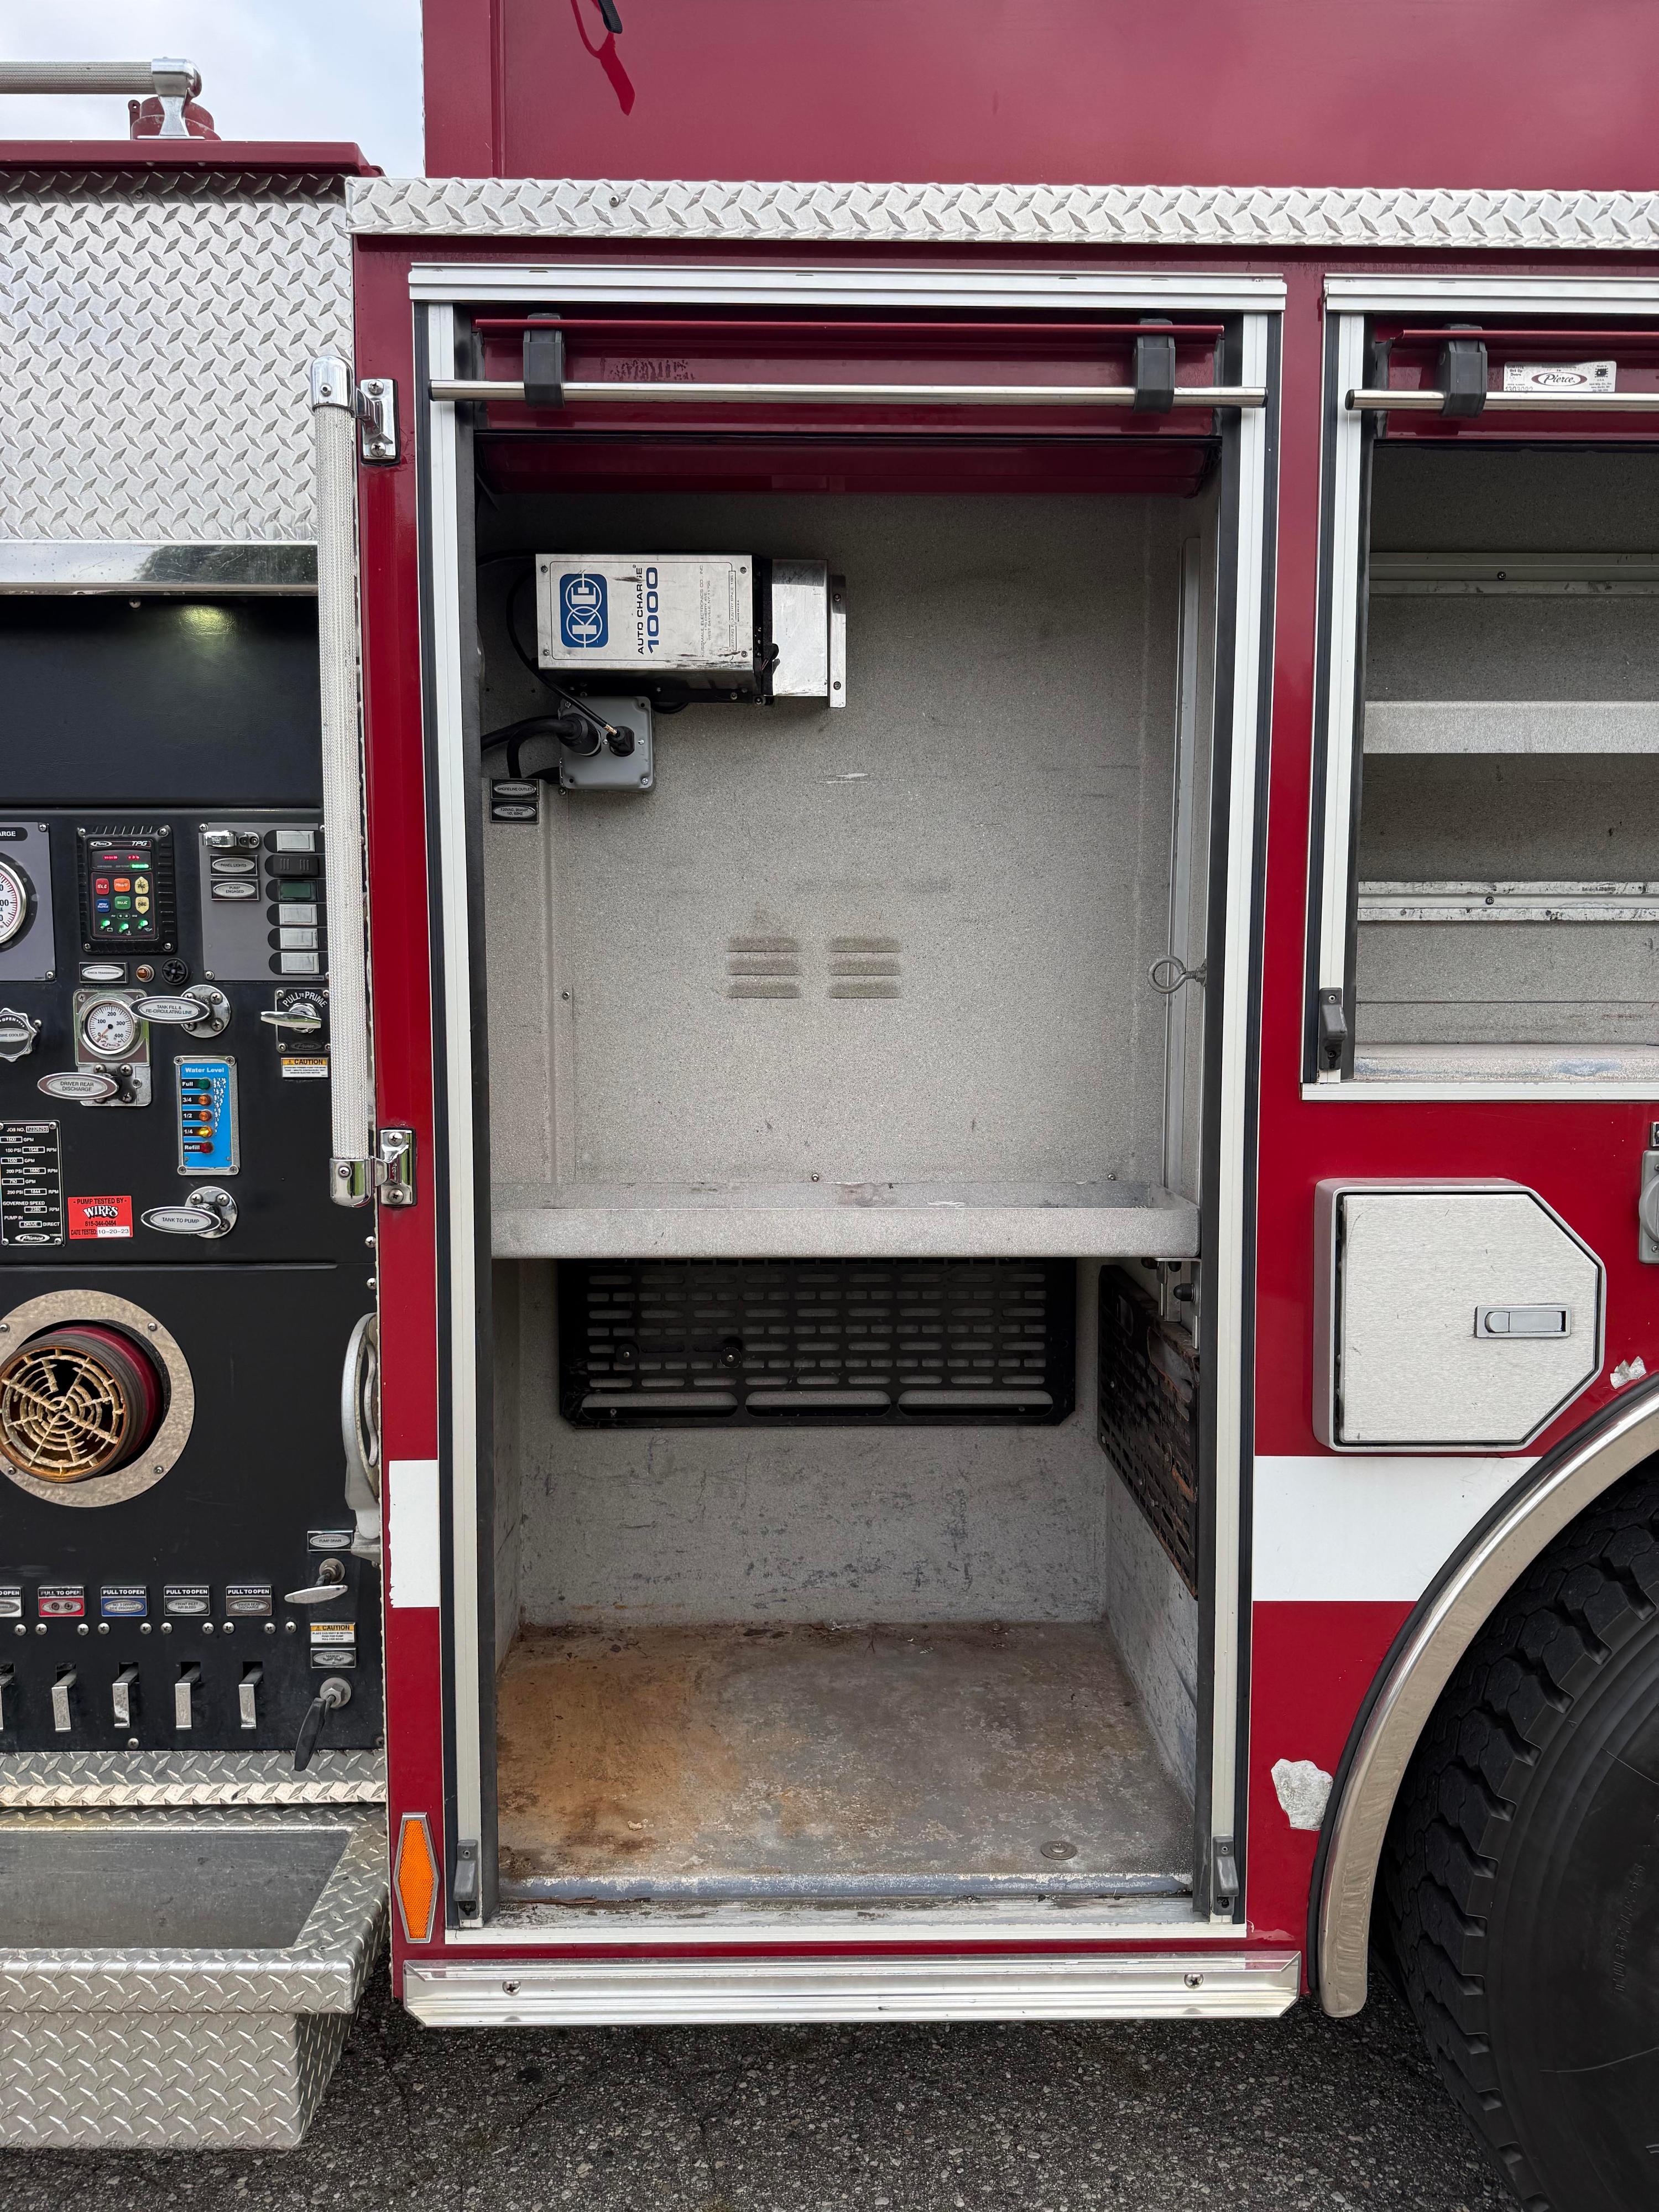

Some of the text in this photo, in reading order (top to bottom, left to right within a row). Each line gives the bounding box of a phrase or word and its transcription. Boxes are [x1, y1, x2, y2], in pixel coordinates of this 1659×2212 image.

[1543, 374, 1574, 384] Pierce
[646, 567, 659, 654] 1000
[282, 992, 301, 1007] PULL
[305, 991, 328, 1008] PRIME
[83, 1205, 119, 1219] WIRFS
